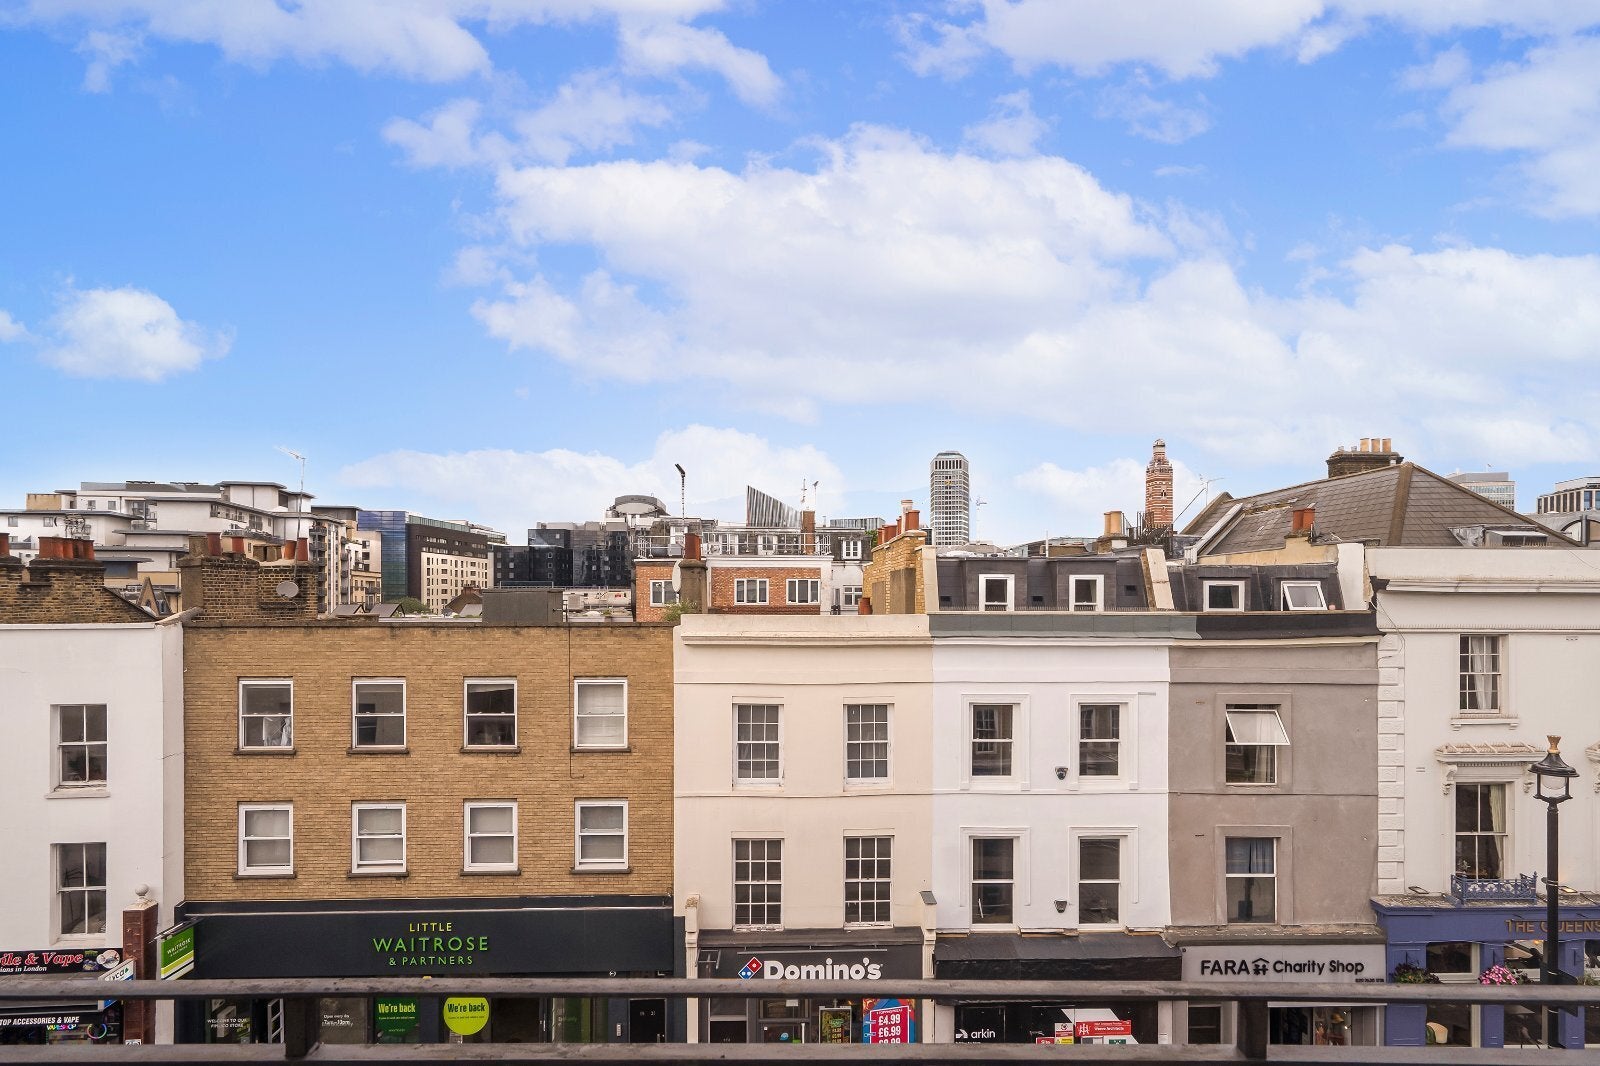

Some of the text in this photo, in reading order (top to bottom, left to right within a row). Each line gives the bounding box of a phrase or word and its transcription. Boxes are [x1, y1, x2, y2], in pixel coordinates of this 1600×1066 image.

[409, 922, 452, 932] LITTLE
[1505, 920, 1535, 933] THE
[373, 936, 489, 952] WAITROSE
[0, 952, 84, 967] ile & Vape
[389, 956, 473, 966] & PARTNERS
[763, 957, 882, 980] Domino's
[1200, 959, 1365, 976] FARA Charity Shop
[378, 1002, 416, 1013] We're back
[447, 1002, 486, 1013] We're back
[13, 1016, 56, 1025] ACCESSORIES
[878, 1013, 901, 1026] £4.99
[878, 1026, 901, 1038] £6.99
[970, 1028, 996, 1039] arkin
